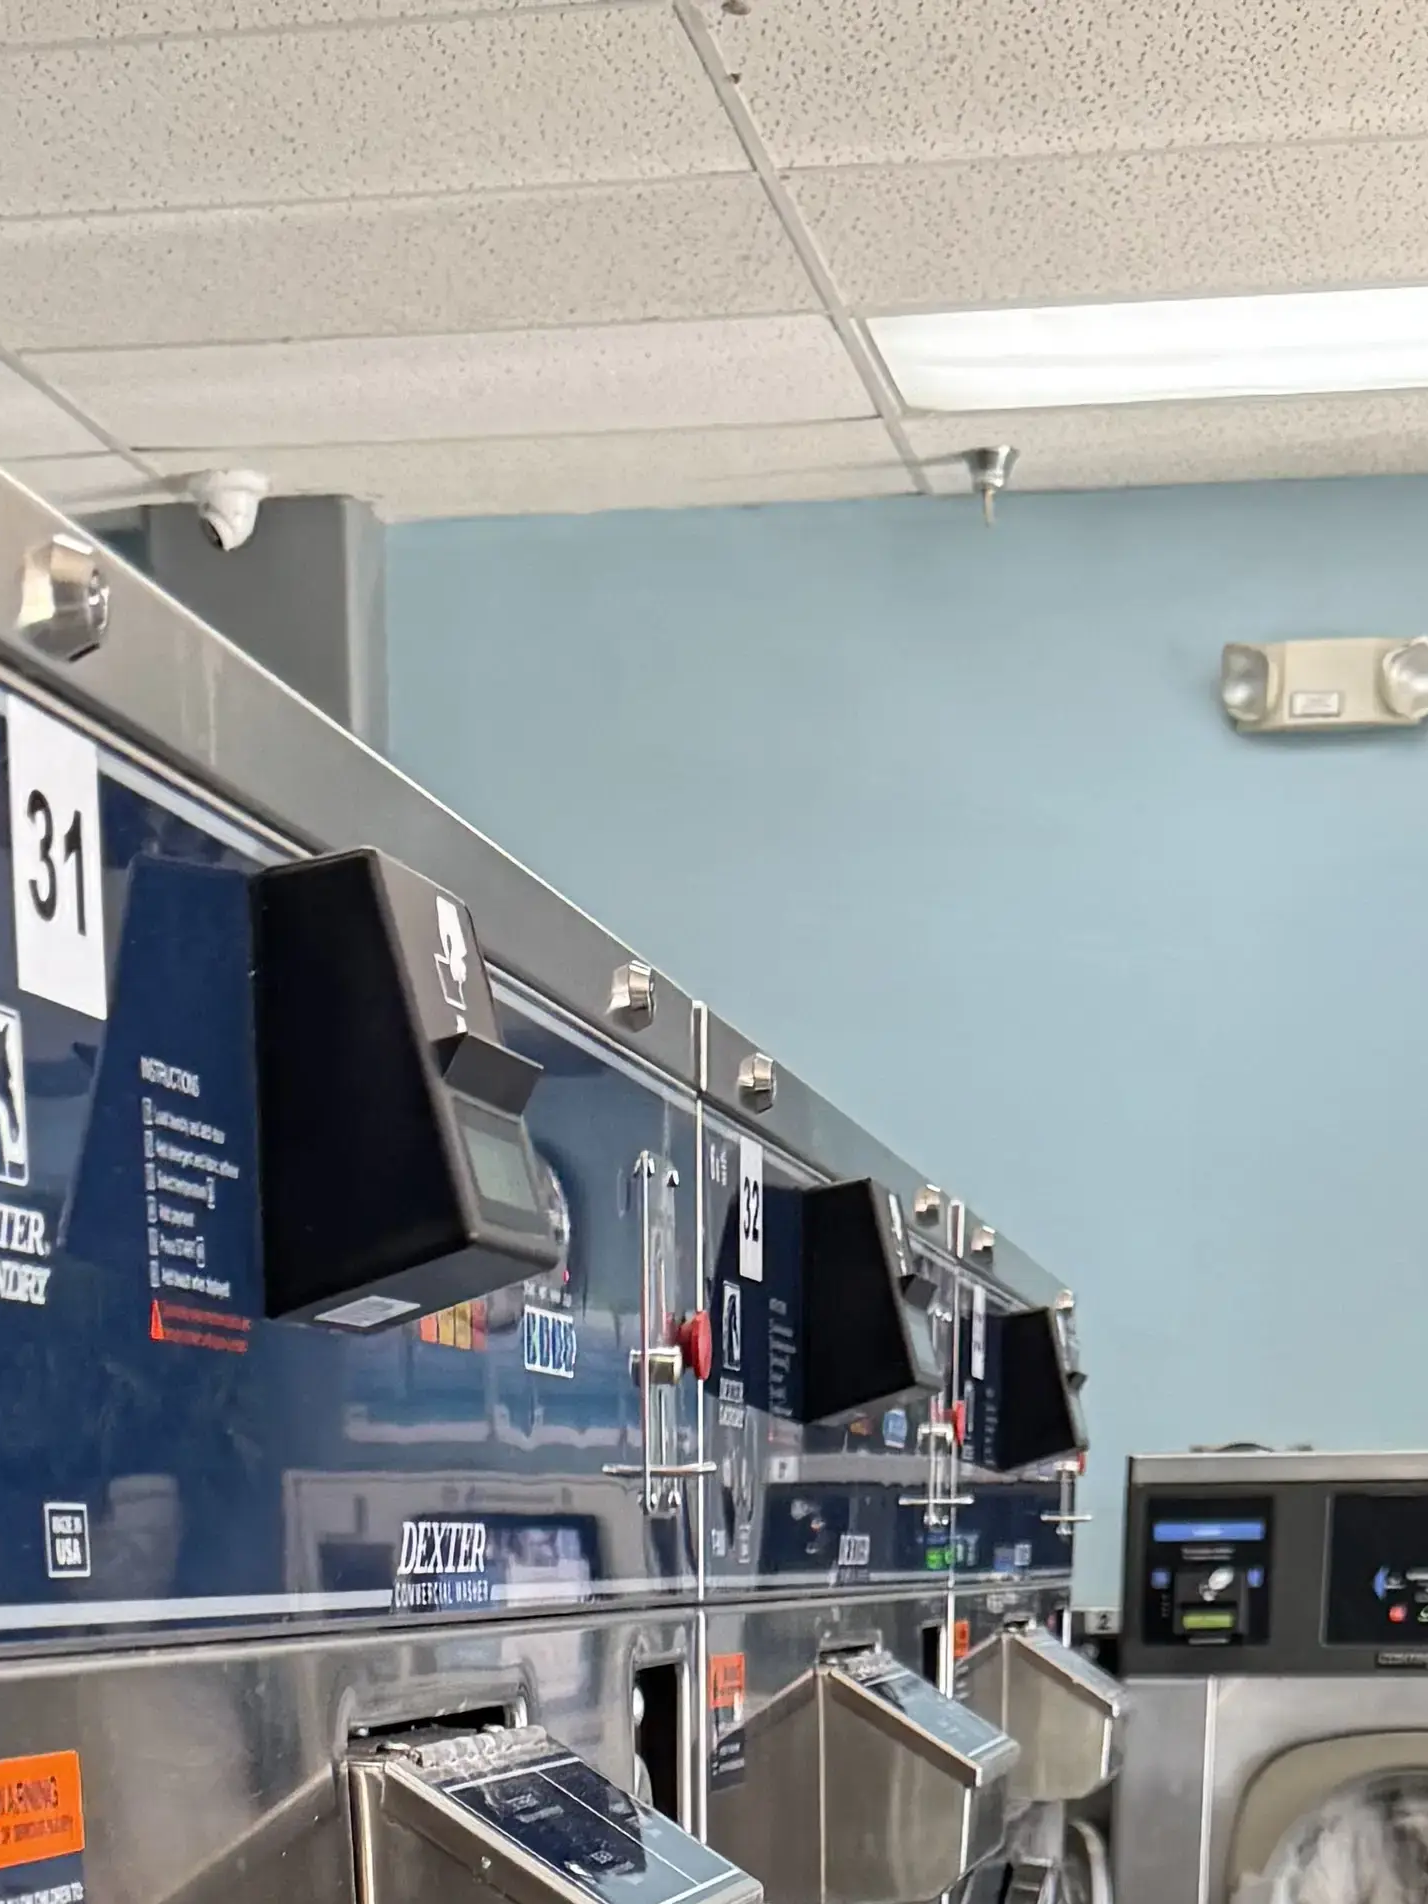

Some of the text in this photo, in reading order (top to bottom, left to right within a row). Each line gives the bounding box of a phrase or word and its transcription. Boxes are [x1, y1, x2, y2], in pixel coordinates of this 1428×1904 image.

[27, 789, 87, 937] 31
[744, 1176, 760, 1242] 32
[397, 1520, 487, 1576] DEXTER
